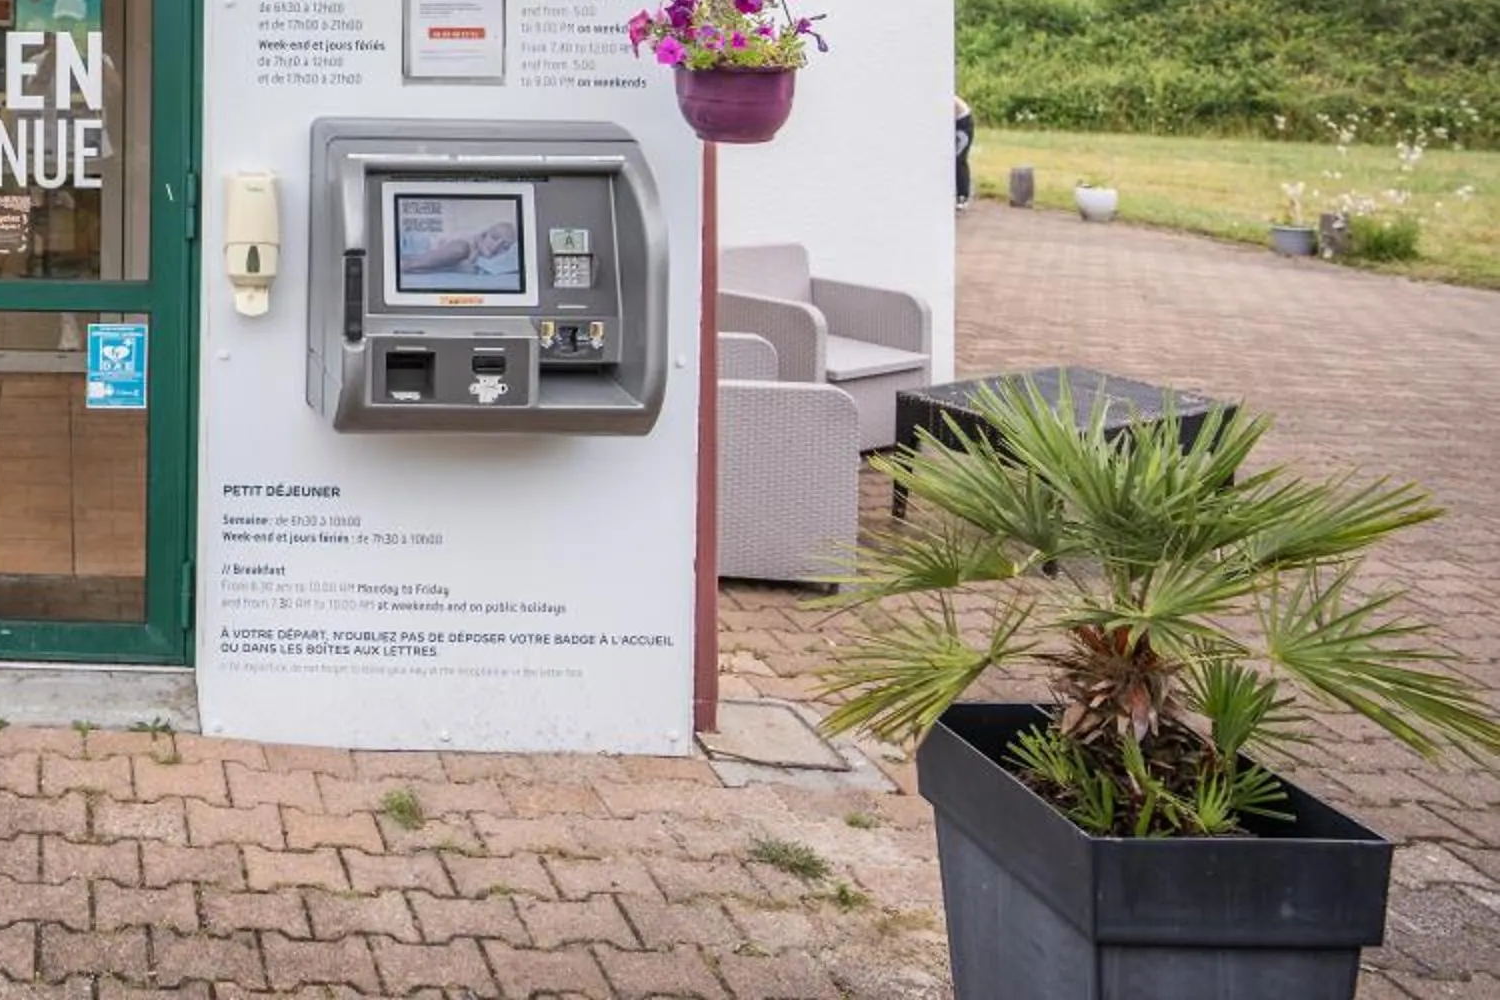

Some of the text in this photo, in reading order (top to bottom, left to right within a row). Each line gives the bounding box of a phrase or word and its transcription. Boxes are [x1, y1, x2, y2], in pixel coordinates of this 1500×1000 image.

[258, 39, 386, 53] Week-end et jours fériés
[593, 76, 647, 89] weekends
[222, 483, 341, 498] PETIT DÉJEUNER
[222, 514, 269, 526] Semaine
[222, 532, 274, 543] Week-end
[276, 532, 288, 543] et
[289, 532, 317, 545] jours
[233, 564, 286, 576] Breakfast
[357, 583, 399, 596] Monday
[402, 584, 413, 595] to
[416, 584, 450, 597] Friday
[391, 600, 445, 612] weekends
[447, 601, 467, 613] and
[469, 603, 483, 613] on
[485, 601, 518, 615] public
[520, 601, 566, 616] holidays
[220, 626, 229, 639] À
[233, 629, 273, 639] VOTRE
[333, 631, 397, 643] N'OUBLIEZ
[401, 632, 425, 643] PAS
[427, 632, 445, 643] DE
[449, 631, 506, 644] DÉPOSER
[509, 633, 551, 645] VOTRE
[554, 634, 596, 645] BADGE
[599, 631, 609, 645] À
[611, 634, 674, 646] L'ACCUEIL
[221, 641, 437, 657] OU DANS LES BOÎTES AUX LETTRES
